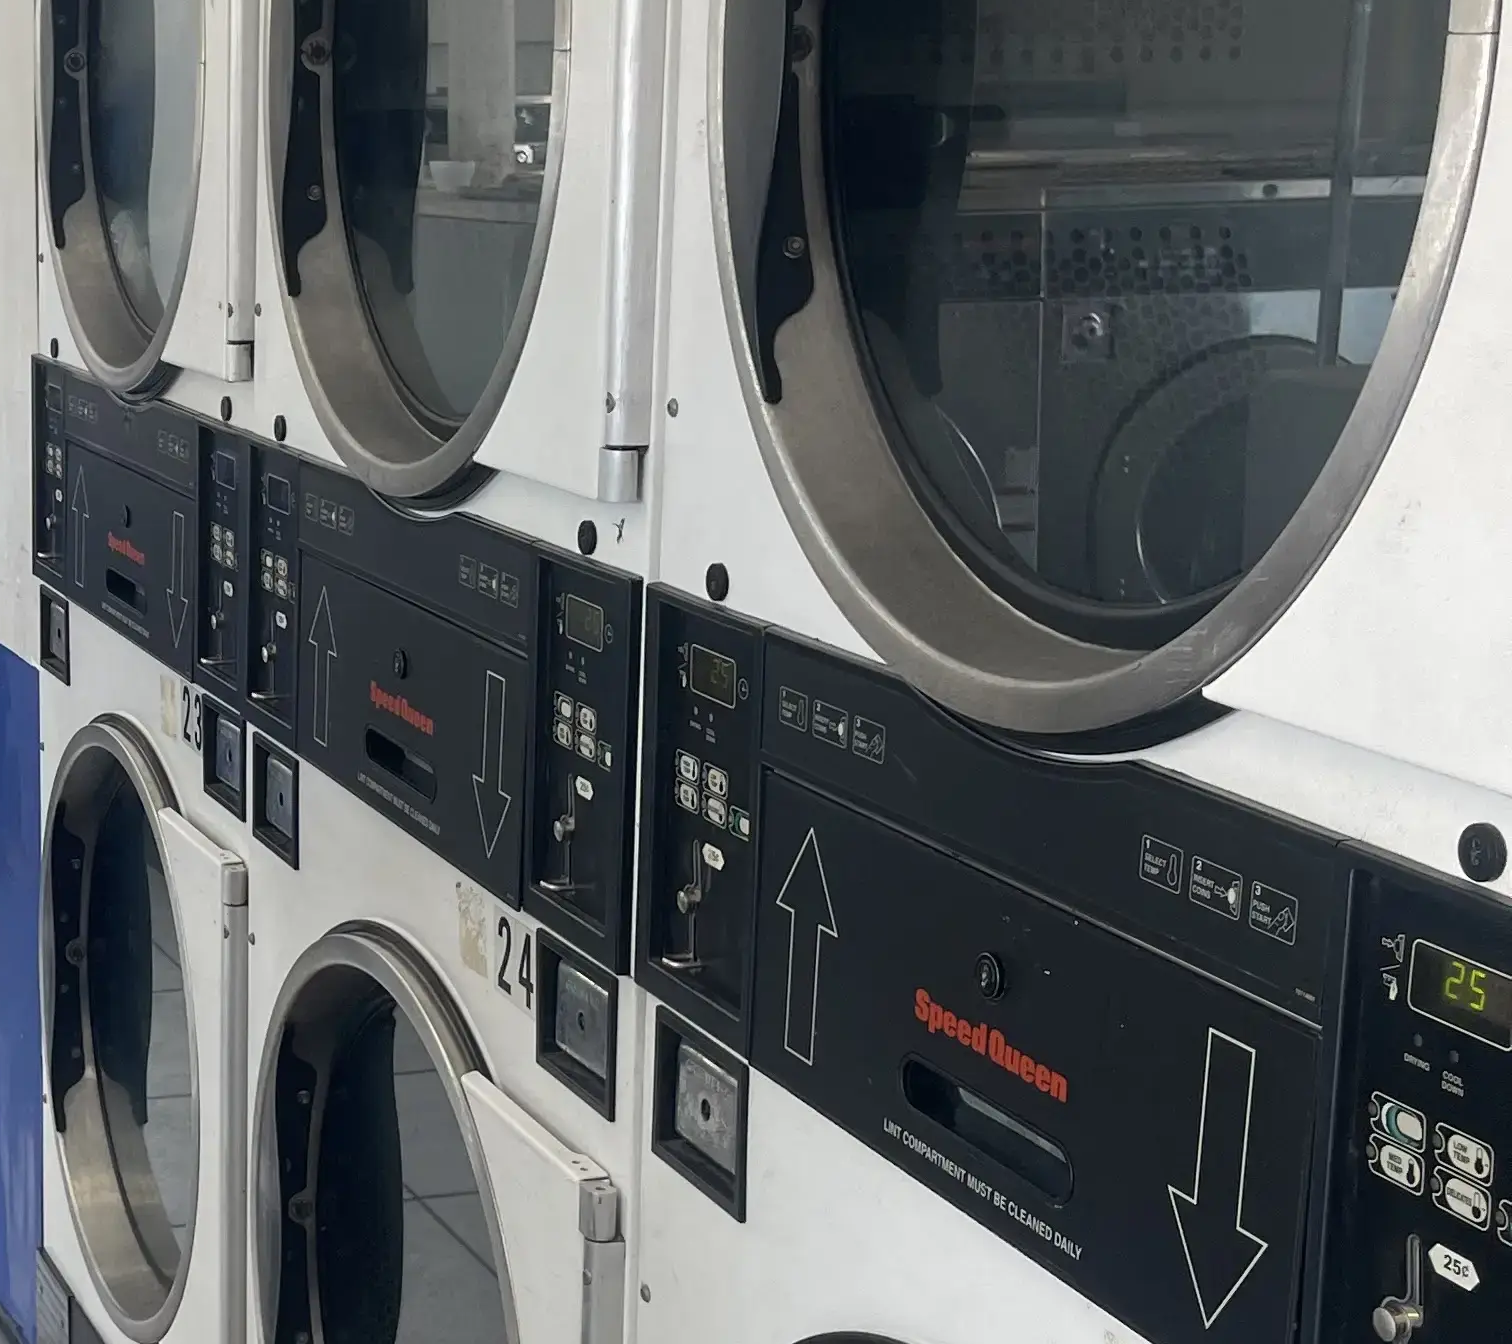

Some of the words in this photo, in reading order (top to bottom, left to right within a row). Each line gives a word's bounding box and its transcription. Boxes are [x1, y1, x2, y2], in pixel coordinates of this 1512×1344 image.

[183, 685, 201, 751] 23
[370, 680, 401, 716] Speed
[401, 698, 434, 736] Queen
[1145, 839, 1151, 849] 1
[1196, 860, 1202, 871] 2
[1254, 886, 1261, 896] 3
[498, 916, 534, 1010] 24
[1445, 960, 1486, 1011] 25
[914, 988, 987, 1056] Speed
[988, 1028, 1068, 1103] Queen
[1441, 1081, 1465, 1097] DOWN
[1442, 1070, 1464, 1087] COOL
[883, 1117, 902, 1139] LINT
[902, 1131, 966, 1183] COMPARTMENT
[967, 1173, 992, 1200] MUST
[993, 1191, 1007, 1211] BE
[1008, 1201, 1053, 1241] CLEANED
[1054, 1232, 1082, 1261] DAILY
[1443, 1254, 1469, 1278] 25¢
